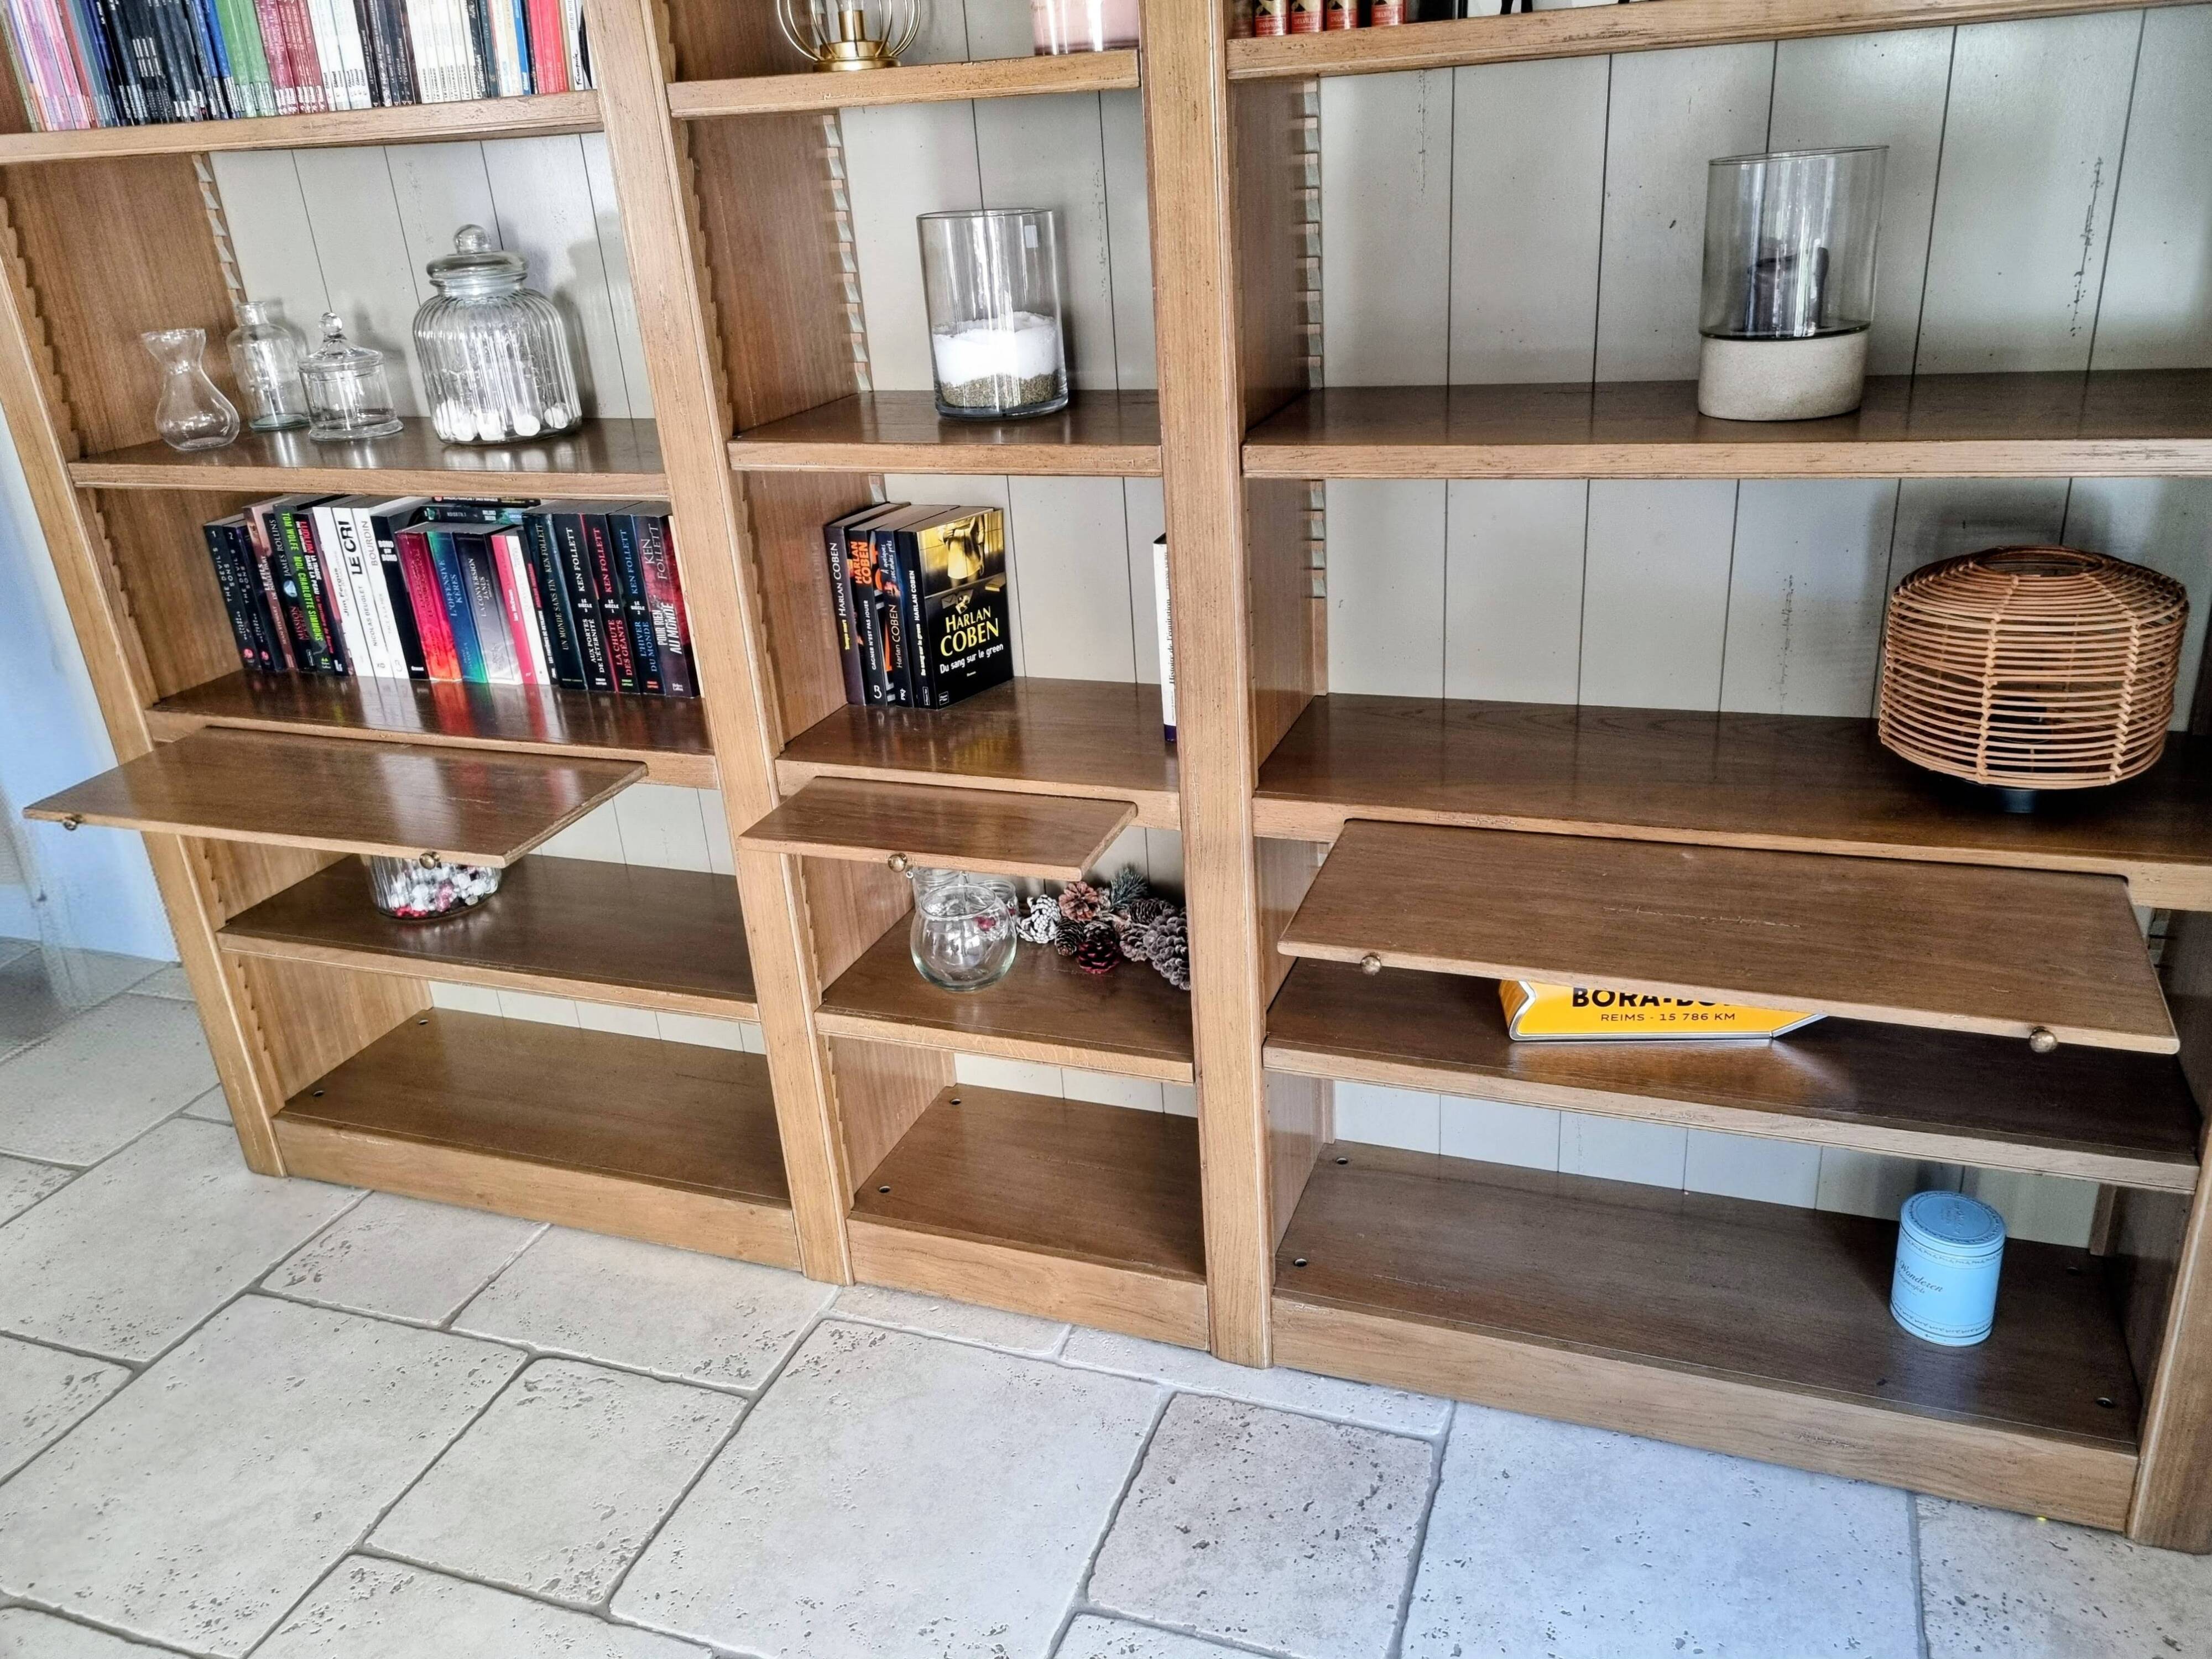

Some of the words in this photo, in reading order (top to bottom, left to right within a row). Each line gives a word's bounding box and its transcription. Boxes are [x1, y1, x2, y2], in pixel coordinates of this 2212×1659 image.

[282, 513, 291, 526] TOM
[269, 519, 283, 551] ROLLINS
[286, 529, 298, 551] WOLFE
[300, 521, 314, 553] LUDLUM
[337, 520, 357, 551] CRI
[361, 520, 378, 566] BOURDIN
[535, 523, 548, 555] FOLLETT
[566, 526, 580, 570] FOLLETT
[593, 527, 607, 571] FOLLETT
[348, 556, 363, 573] LE
[543, 557, 552, 572] KEN
[620, 529, 633, 572] FOLLETT
[641, 538, 654, 564] KEN
[648, 523, 666, 580] FOLLETT
[830, 542, 841, 580] COBEN
[851, 541, 862, 584] HARLAN
[858, 541, 872, 583] COBEN
[880, 544, 889, 567] quelques
[224, 564, 234, 586] SONS
[257, 564, 266, 580] FILS
[280, 555, 291, 576] JAMES
[304, 555, 313, 570] DANS
[311, 580, 319, 594] PEAU
[310, 562, 323, 579] TRAQUE
[887, 554, 895, 579] secondes
[334, 567, 345, 597] Fergus
[437, 559, 457, 616] L'OFFENSIVE
[468, 557, 483, 606] CONVERSION
[478, 576, 490, 599] JANUS
[576, 572, 585, 591] KEN
[603, 573, 612, 592] KEN
[629, 575, 638, 594] KEN
[298, 573, 314, 608] CHARLOTTE
[308, 611, 322, 641] SIMMONS
[358, 585, 369, 615] BEUGLET
[479, 607, 486, 616] LA
[508, 589, 516, 611] McEwan
[551, 593, 560, 611] SANS
[836, 582, 846, 616] HARLAN
[556, 613, 565, 638] MONDE
[651, 609, 664, 625] RIEN
[662, 602, 679, 639] MONDE
[889, 604, 900, 642] COBEN
[945, 606, 992, 634] HARLAN
[367, 617, 377, 646] NICOLAS
[561, 640, 568, 650] UN
[582, 618, 593, 646] PORTES
[588, 618, 602, 661] L'ÉTERNITÉ
[608, 619, 619, 651] CHUTE
[615, 619, 628, 656] GÉANTS
[635, 621, 646, 657] L'HIVER
[642, 622, 654, 656] MONDE
[655, 627, 667, 645] POUR
[940, 618, 999, 657] COBEN
[615, 654, 622, 665] LA
[669, 639, 681, 654] AU
[940, 664, 950, 674] Du
[951, 658, 965, 668] sang
[967, 654, 977, 663] sur
[978, 649, 985, 659] le
[986, 643, 1004, 658] green
[1168, 643, 1173, 653] de
[598, 662, 604, 672] DE
[649, 658, 656, 672] DU
[1683, 1013, 1709, 1021] 786
[1714, 1013, 1735, 1021] KM
[1897, 1260, 1944, 1293] Wonderen
